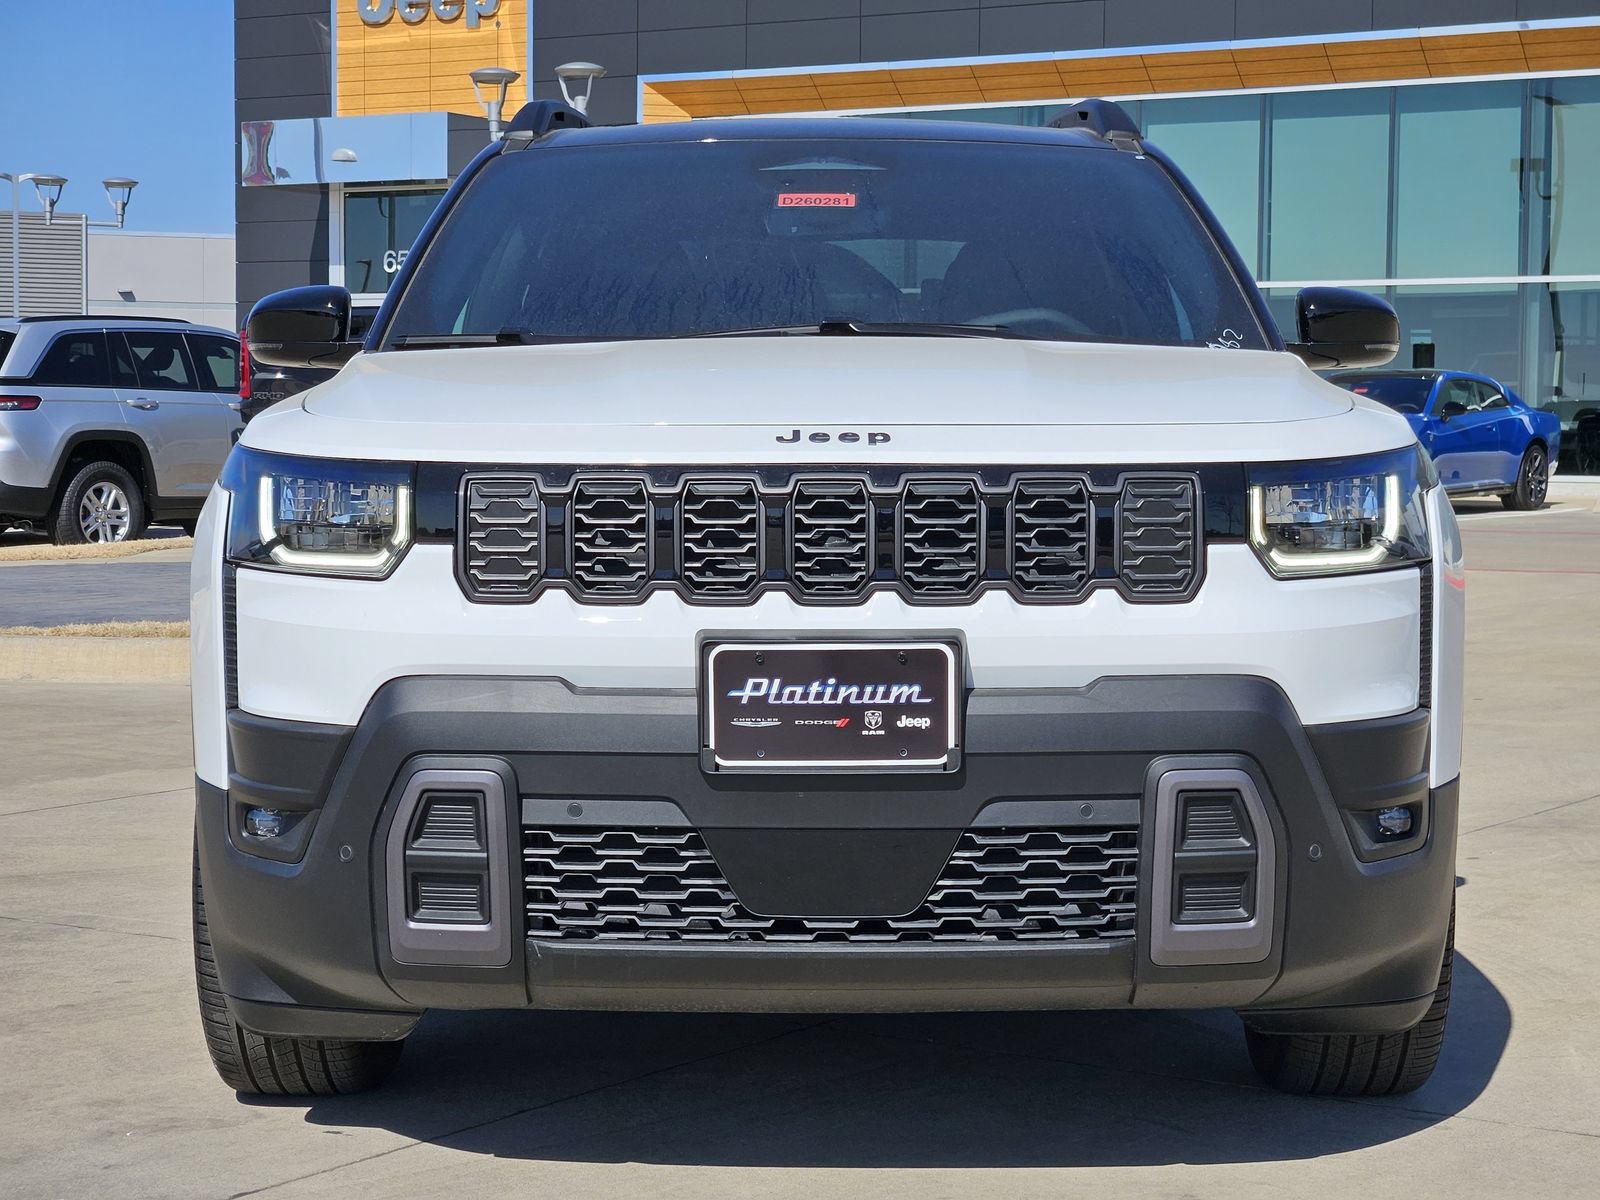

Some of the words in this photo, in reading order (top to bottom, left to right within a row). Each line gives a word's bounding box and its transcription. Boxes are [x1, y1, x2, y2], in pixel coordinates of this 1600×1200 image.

[782, 197, 850, 206] D260281
[775, 429, 891, 446] Jeep
[727, 677, 933, 705] Platinum
[896, 714, 931, 730] Jeep
